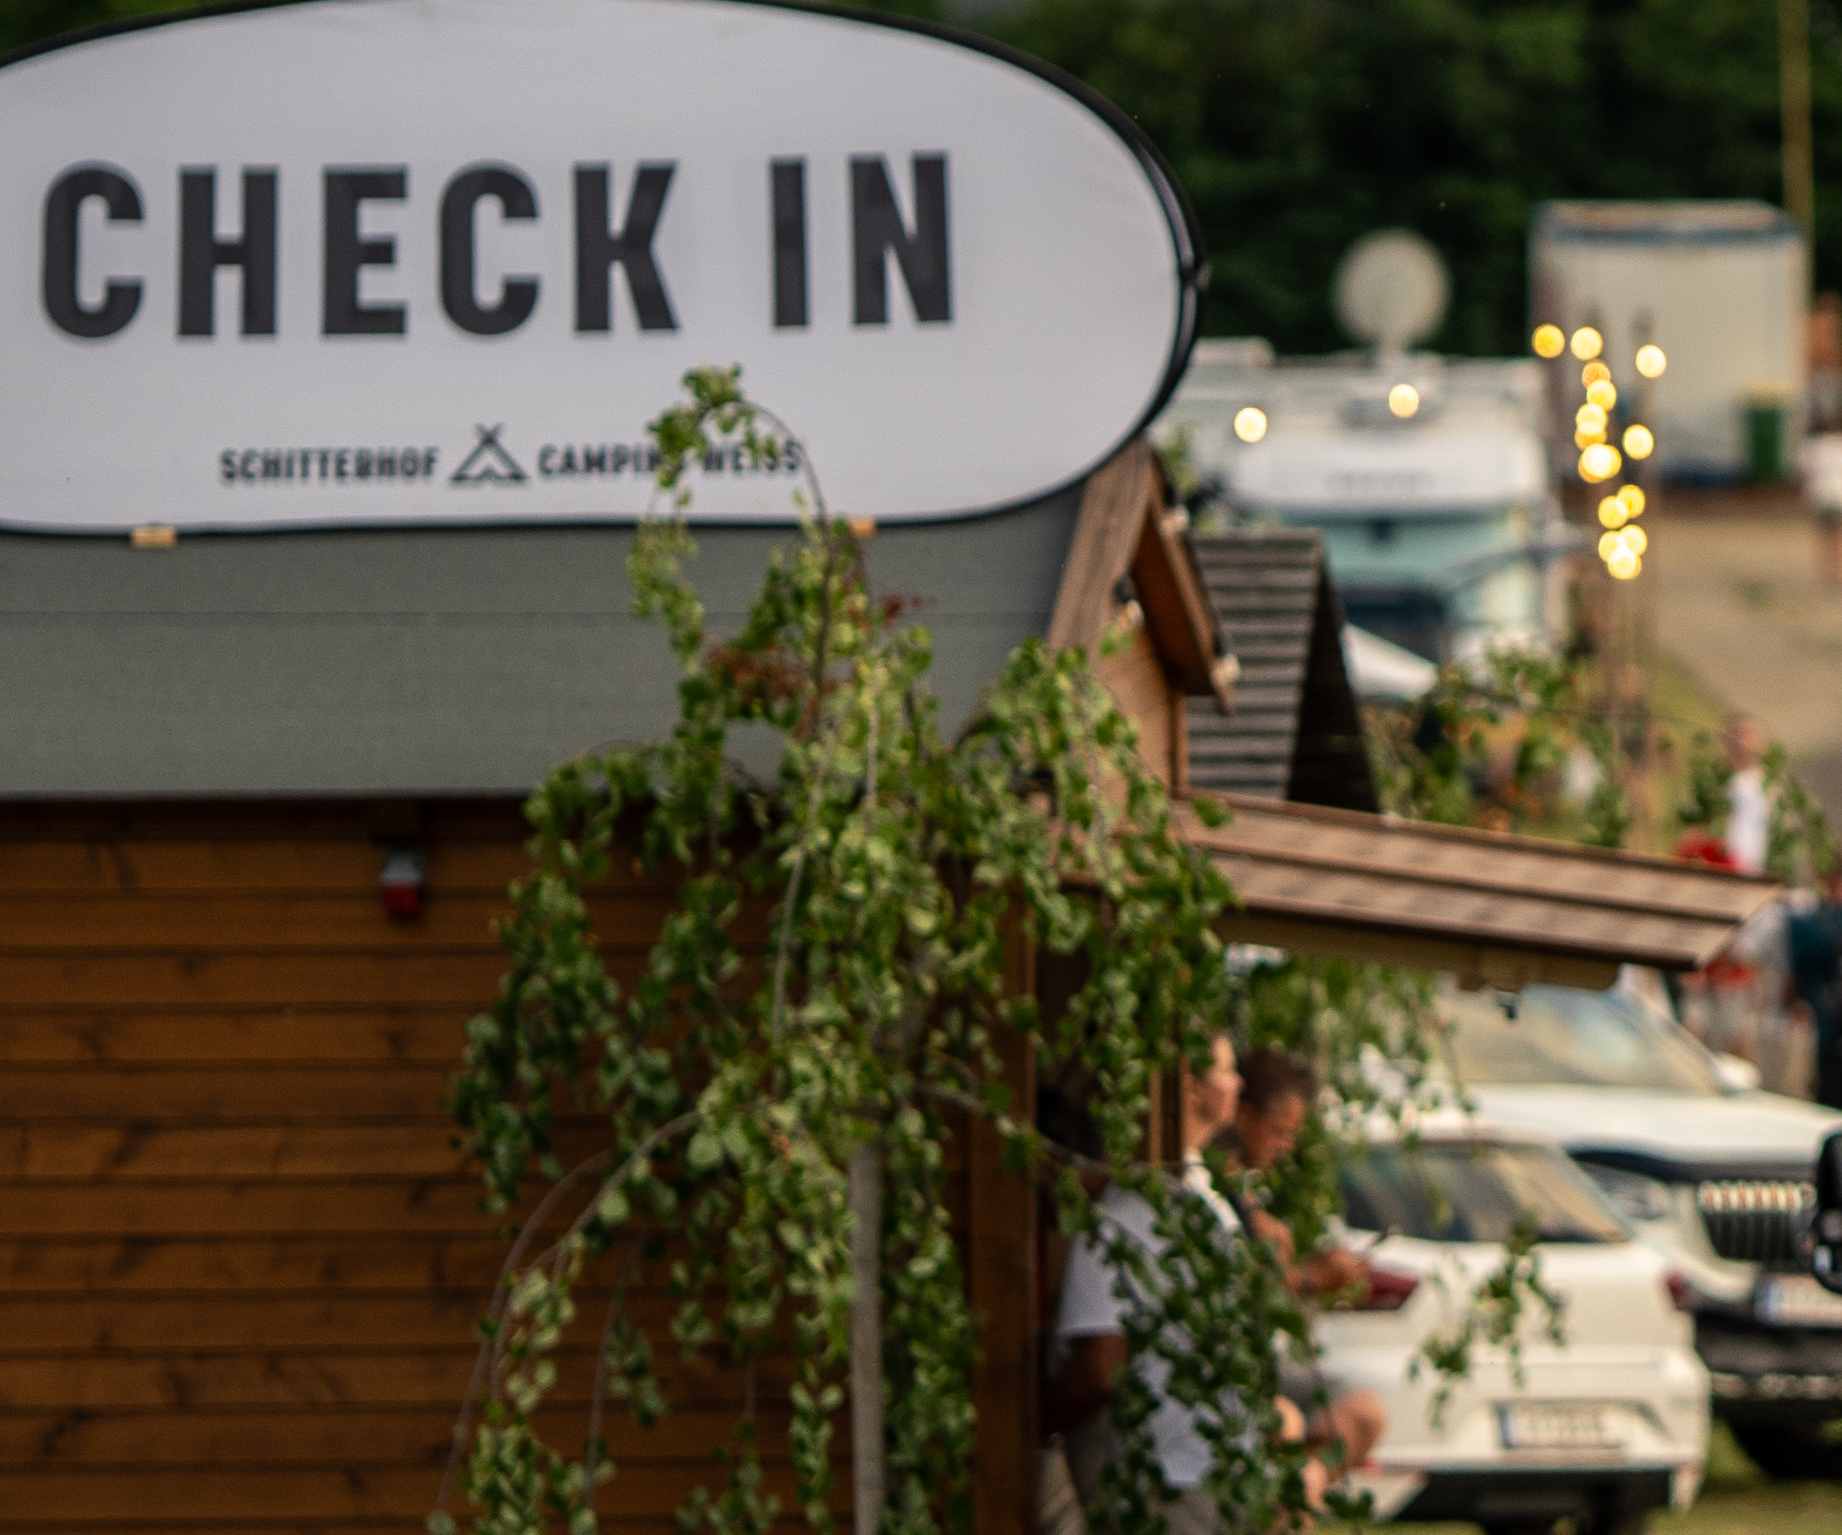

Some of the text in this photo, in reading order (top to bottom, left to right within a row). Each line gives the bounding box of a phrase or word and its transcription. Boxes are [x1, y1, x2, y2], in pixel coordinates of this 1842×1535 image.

[39, 150, 954, 344] CHECK IN
[219, 447, 438, 485] SCHITTERHOF
[538, 443, 686, 478] CAMPIN
